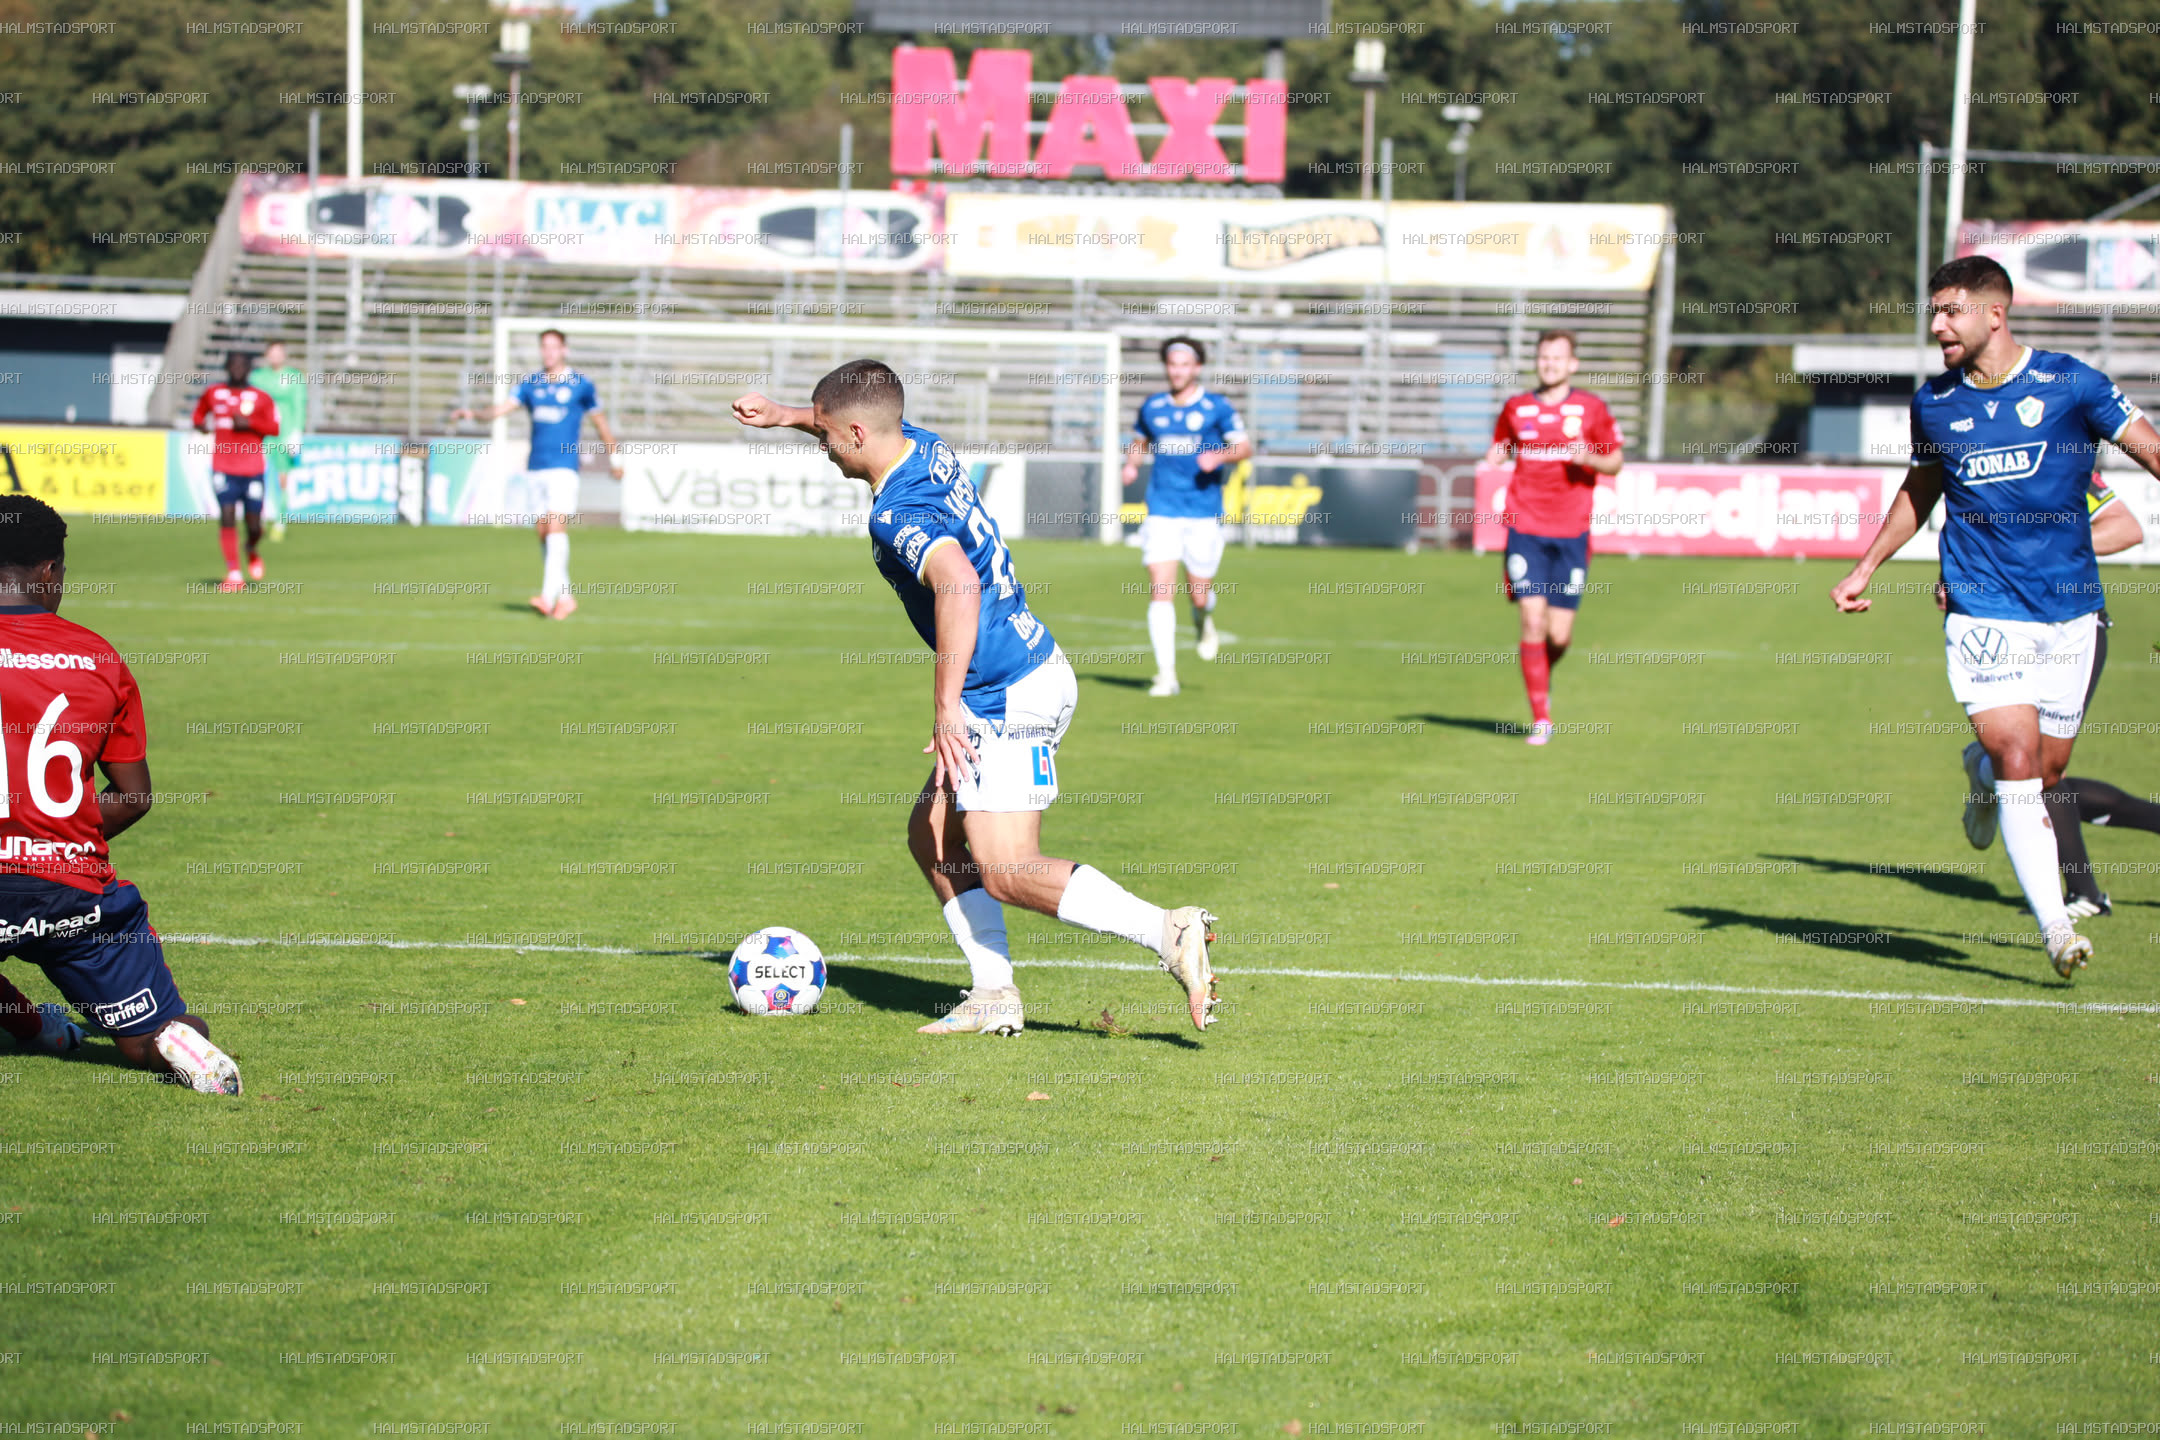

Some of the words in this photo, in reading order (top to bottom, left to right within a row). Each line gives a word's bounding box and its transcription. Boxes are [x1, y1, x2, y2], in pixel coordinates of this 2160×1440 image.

[891, 46, 1288, 183] MAXI
[1966, 450, 2031, 479] JONAB
[643, 467, 874, 511] Västta
[755, 965, 806, 979] SELECT
[104, 996, 149, 1026] griffel
